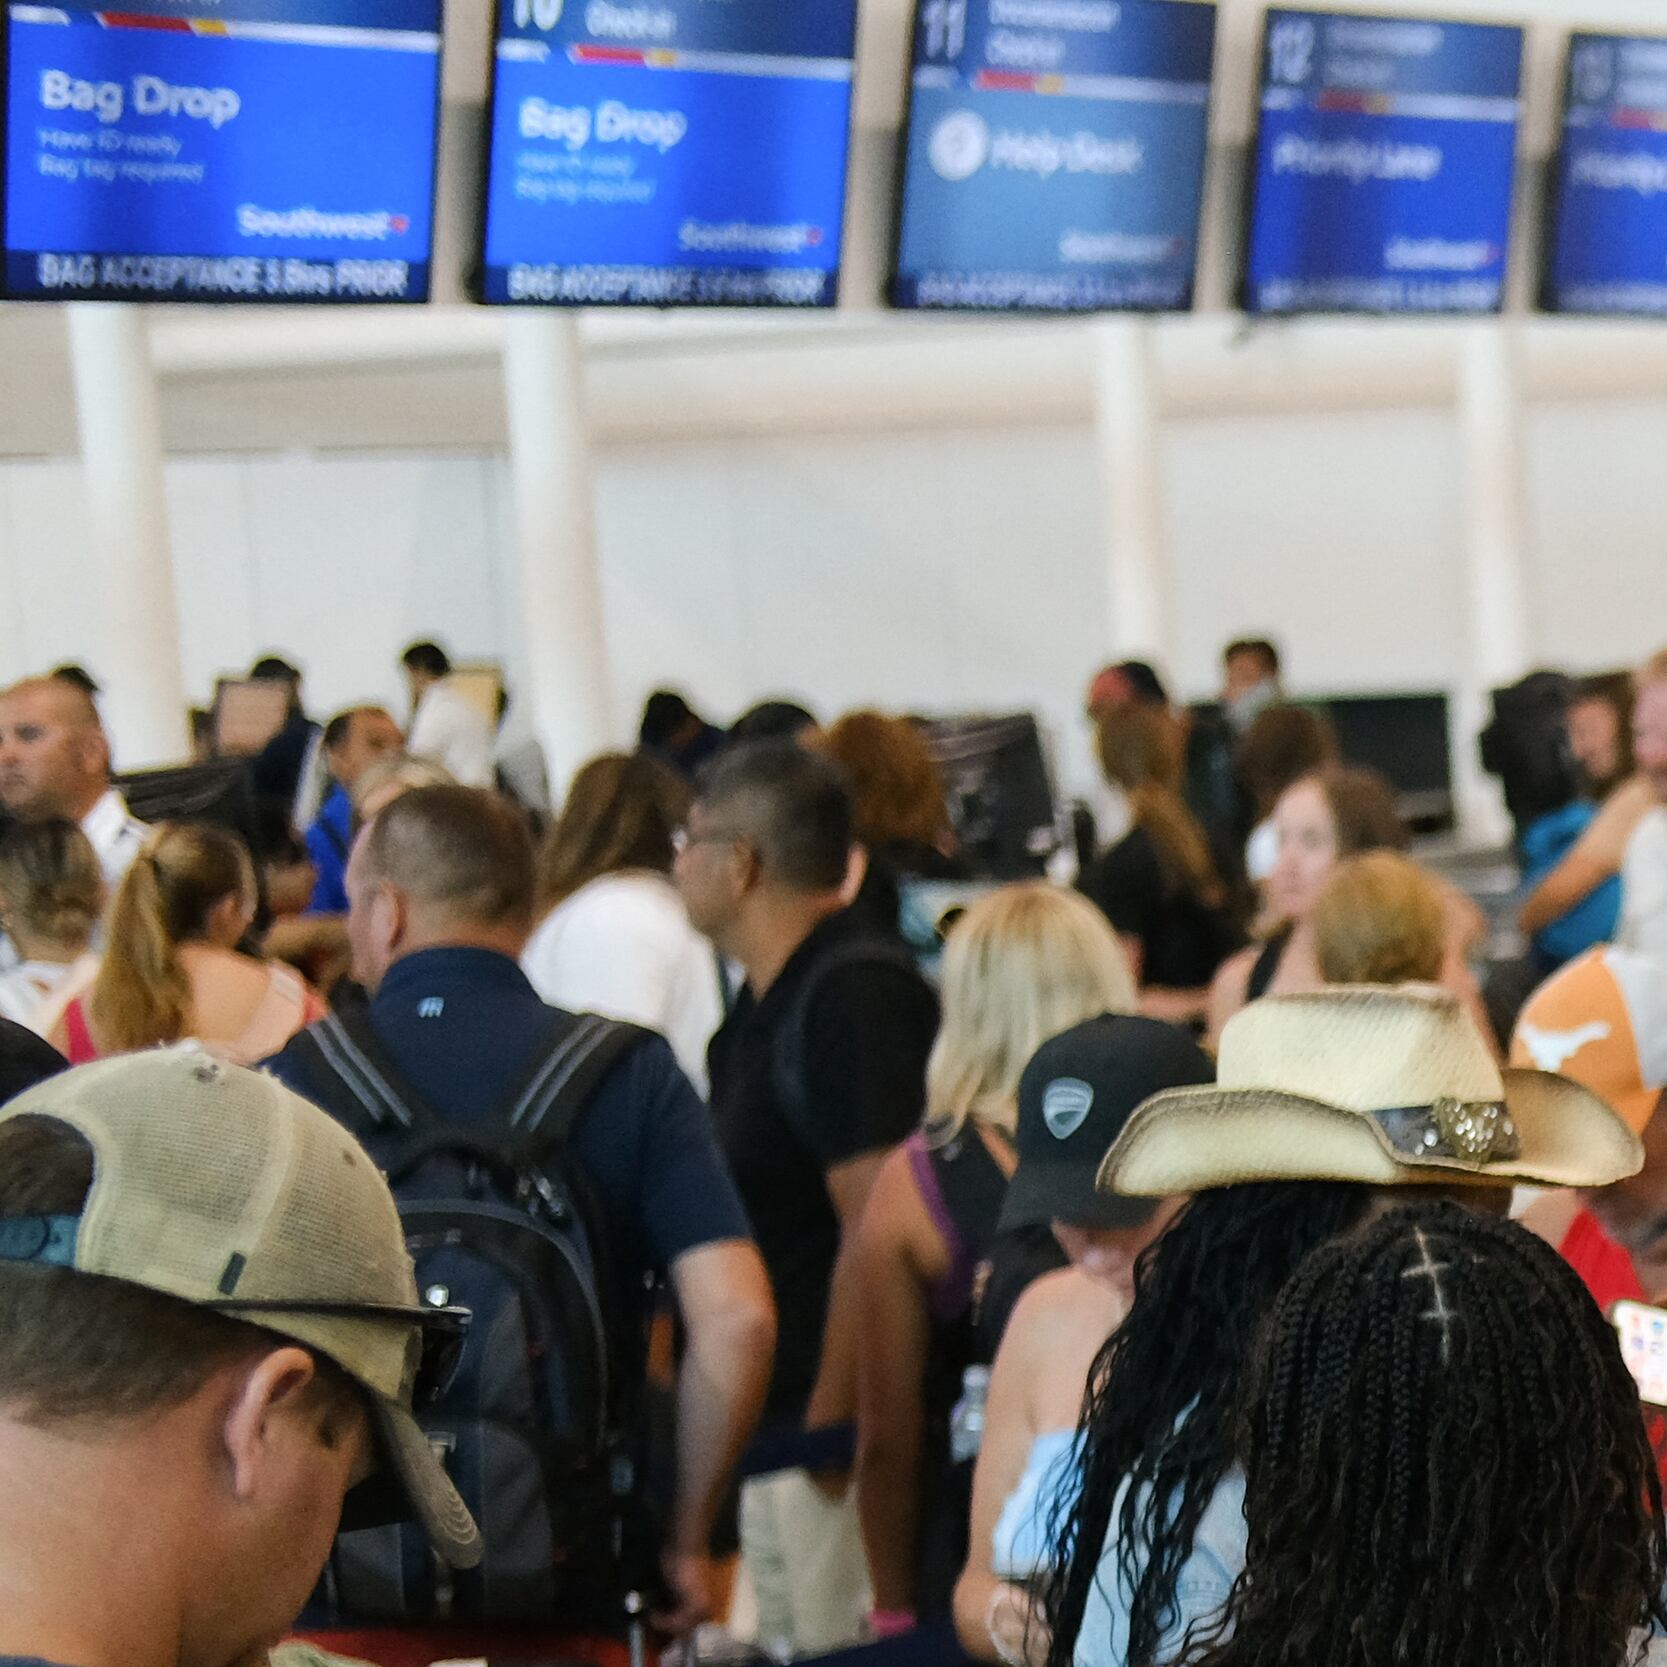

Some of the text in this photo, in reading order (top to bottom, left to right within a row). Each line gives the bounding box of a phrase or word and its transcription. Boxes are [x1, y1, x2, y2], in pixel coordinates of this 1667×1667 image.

[41, 68, 242, 129] Bag Drop
[518, 97, 689, 155] Bag Drop
